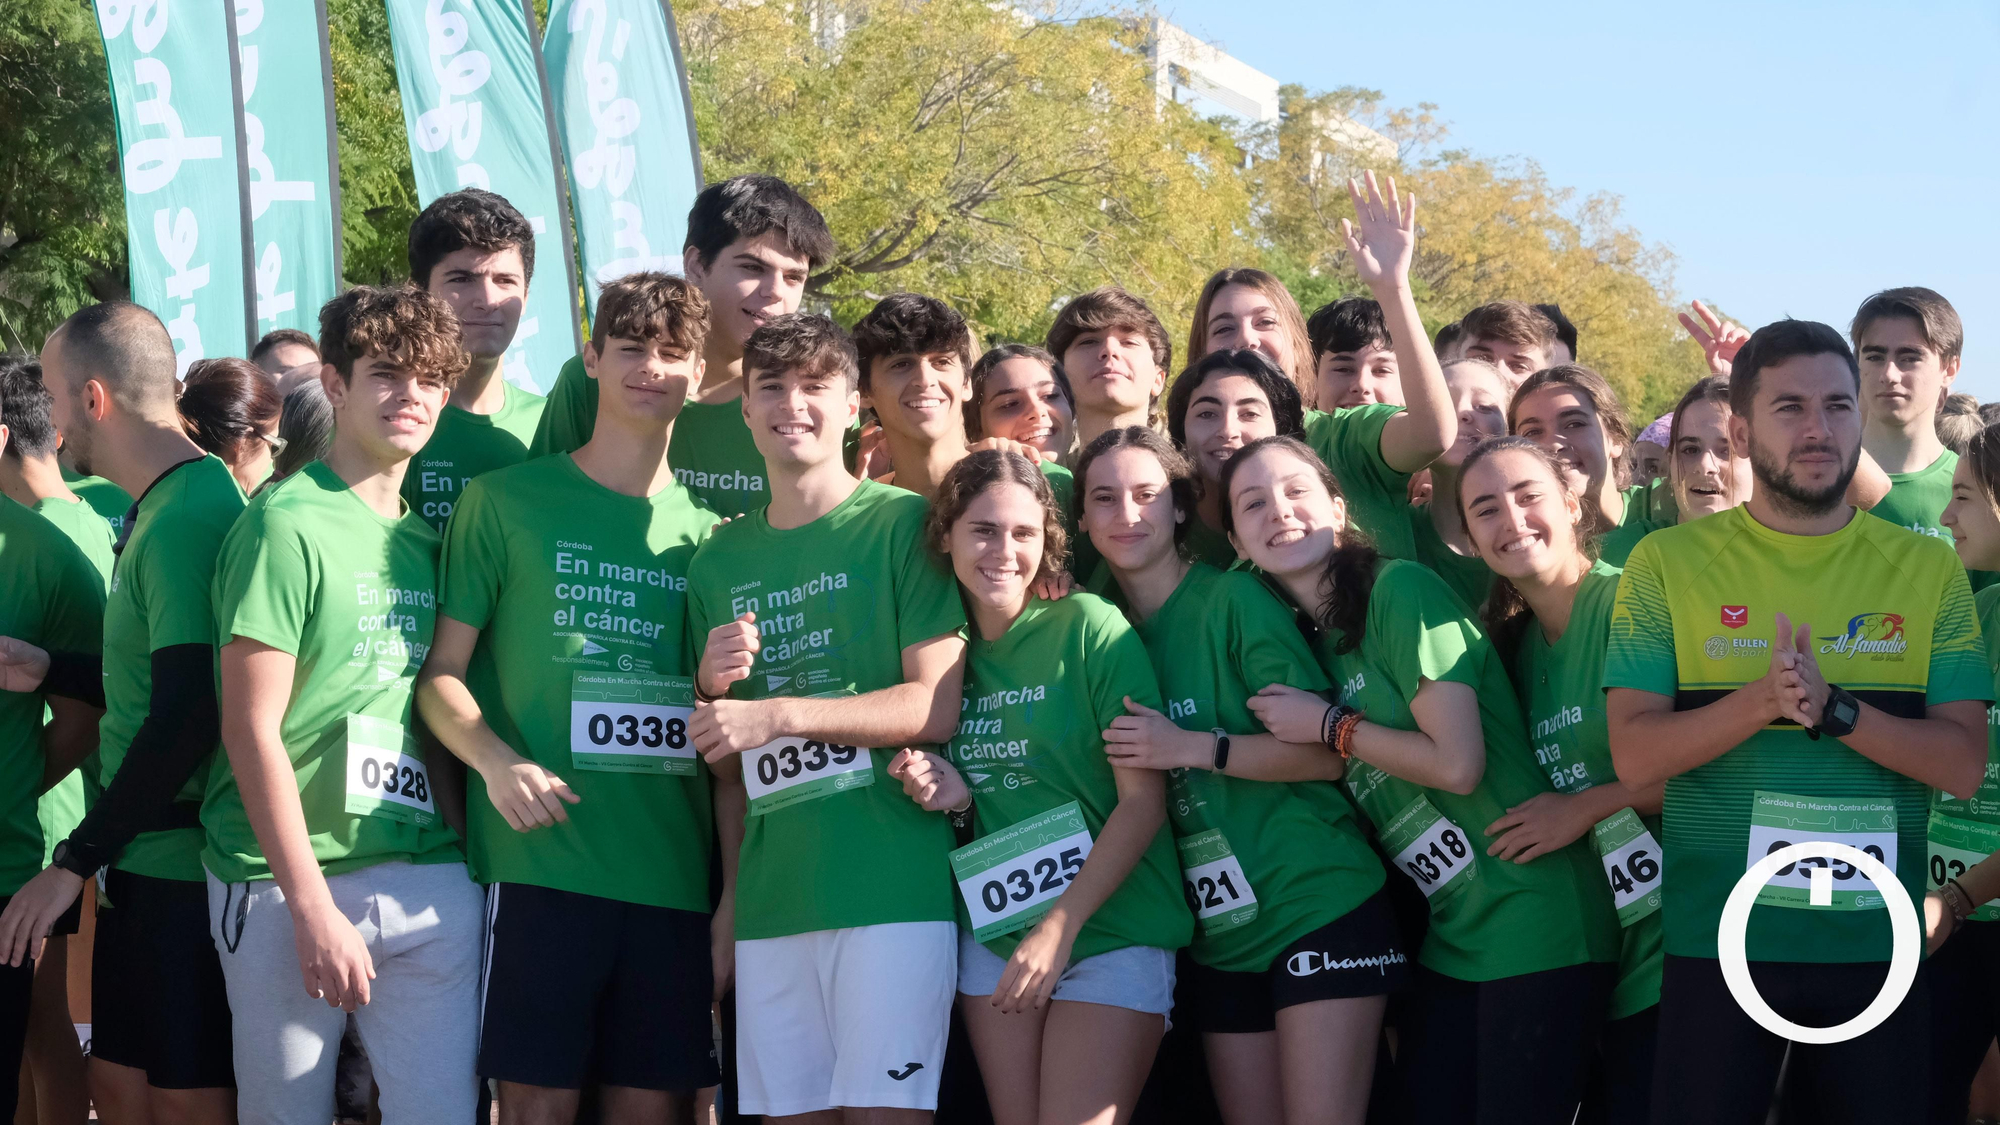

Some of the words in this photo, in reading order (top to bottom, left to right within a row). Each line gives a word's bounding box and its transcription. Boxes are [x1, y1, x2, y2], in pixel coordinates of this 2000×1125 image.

[421, 460, 453, 468] Córdoba
[421, 472, 453, 492] En
[674, 467, 763, 491] marcha
[556, 540, 593, 551] Córdoba
[556, 552, 589, 575] En
[599, 561, 688, 593] marcha
[356, 583, 379, 605] En
[386, 588, 436, 610] march
[554, 583, 636, 608] contra
[730, 580, 762, 594] Córdoba
[731, 596, 760, 620] En
[768, 572, 848, 608] marcha
[358, 610, 416, 632] contra
[553, 605, 575, 626] el
[584, 608, 665, 640] cáncer
[753, 612, 804, 637] ntra
[352, 636, 370, 657] el
[374, 633, 431, 661] cáner
[762, 628, 833, 663] cáncer
[1732, 638, 1768, 648] EULEN
[1732, 648, 1767, 658] Sport
[578, 675, 606, 684] Córdoba
[618, 678, 642, 686] Marcha
[672, 680, 694, 689] Cáncer
[976, 684, 1045, 713] marcha
[588, 713, 687, 750] 0338
[954, 717, 1002, 736] ntra
[960, 738, 1028, 761] cáncer
[757, 740, 857, 786] 0339
[361, 757, 428, 803] 0328
[1759, 797, 1794, 808] Córdoba
[1808, 802, 1838, 812] Marcha
[1838, 804, 1862, 812] Contra
[1870, 804, 1894, 812] Cáncer
[1608, 812, 1632, 830] Cáncer
[1948, 822, 1970, 832] Marcha
[1970, 826, 1990, 835] Contra
[955, 846, 984, 862] Córdoba
[984, 840, 994, 850] En
[993, 831, 1018, 846] Marcha
[1019, 822, 1042, 834] Contra
[1043, 817, 1051, 825] el
[1051, 808, 1077, 822] Cáncer
[1406, 828, 1466, 886] 0318
[982, 846, 1086, 914] 0325
[1611, 850, 1659, 895] 46
[1184, 870, 1240, 912] 321
